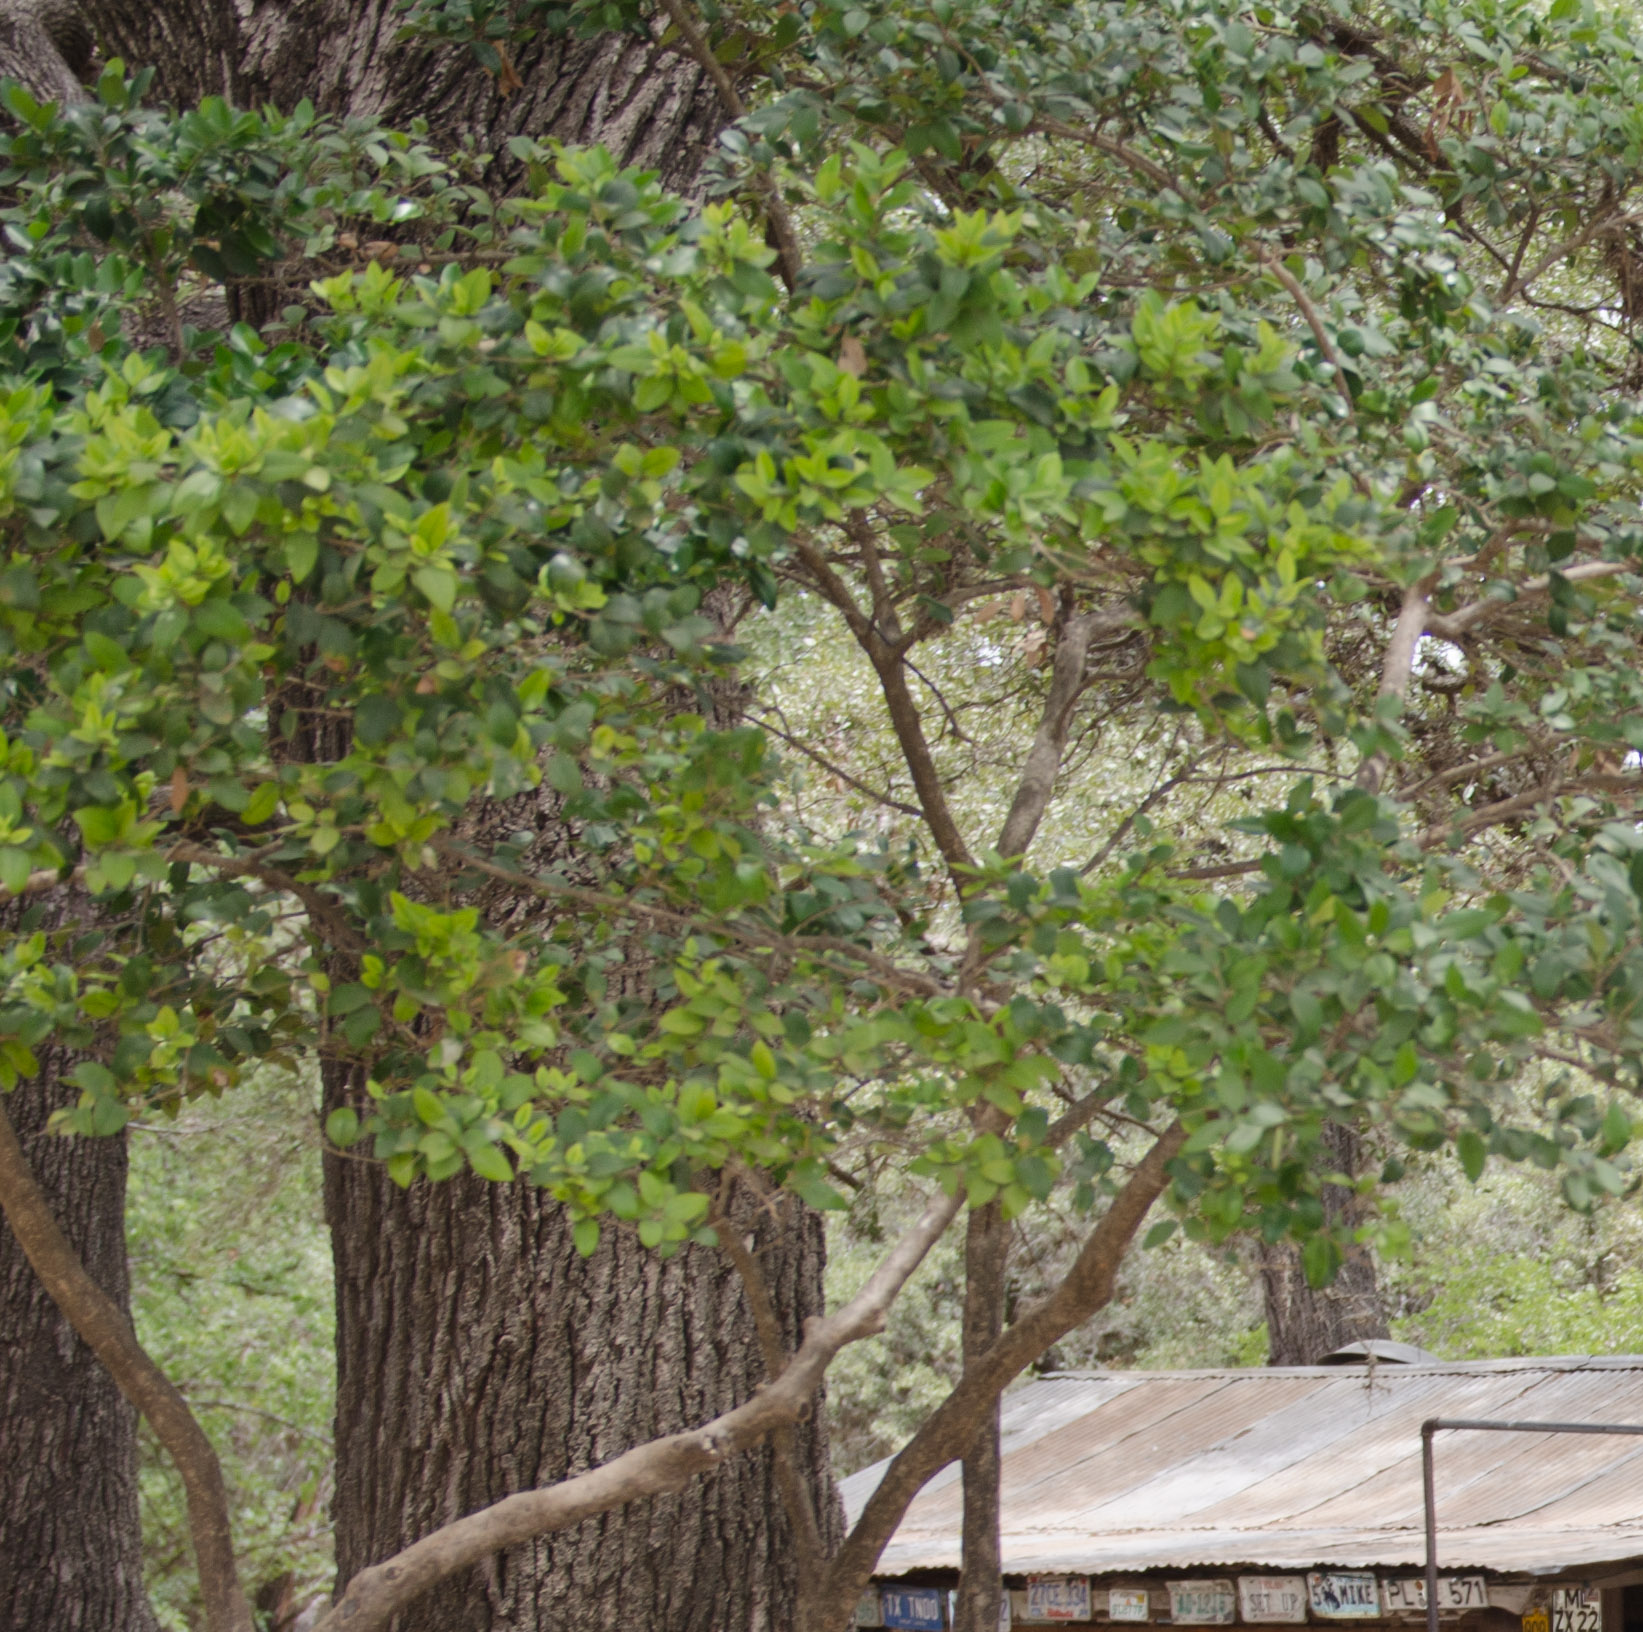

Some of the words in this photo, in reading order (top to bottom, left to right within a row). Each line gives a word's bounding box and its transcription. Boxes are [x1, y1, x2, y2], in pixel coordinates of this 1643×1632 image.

[1281, 1592, 1298, 1611] UP
[1339, 1584, 1374, 1606] MIKE
[1449, 1580, 1484, 1605] 571
